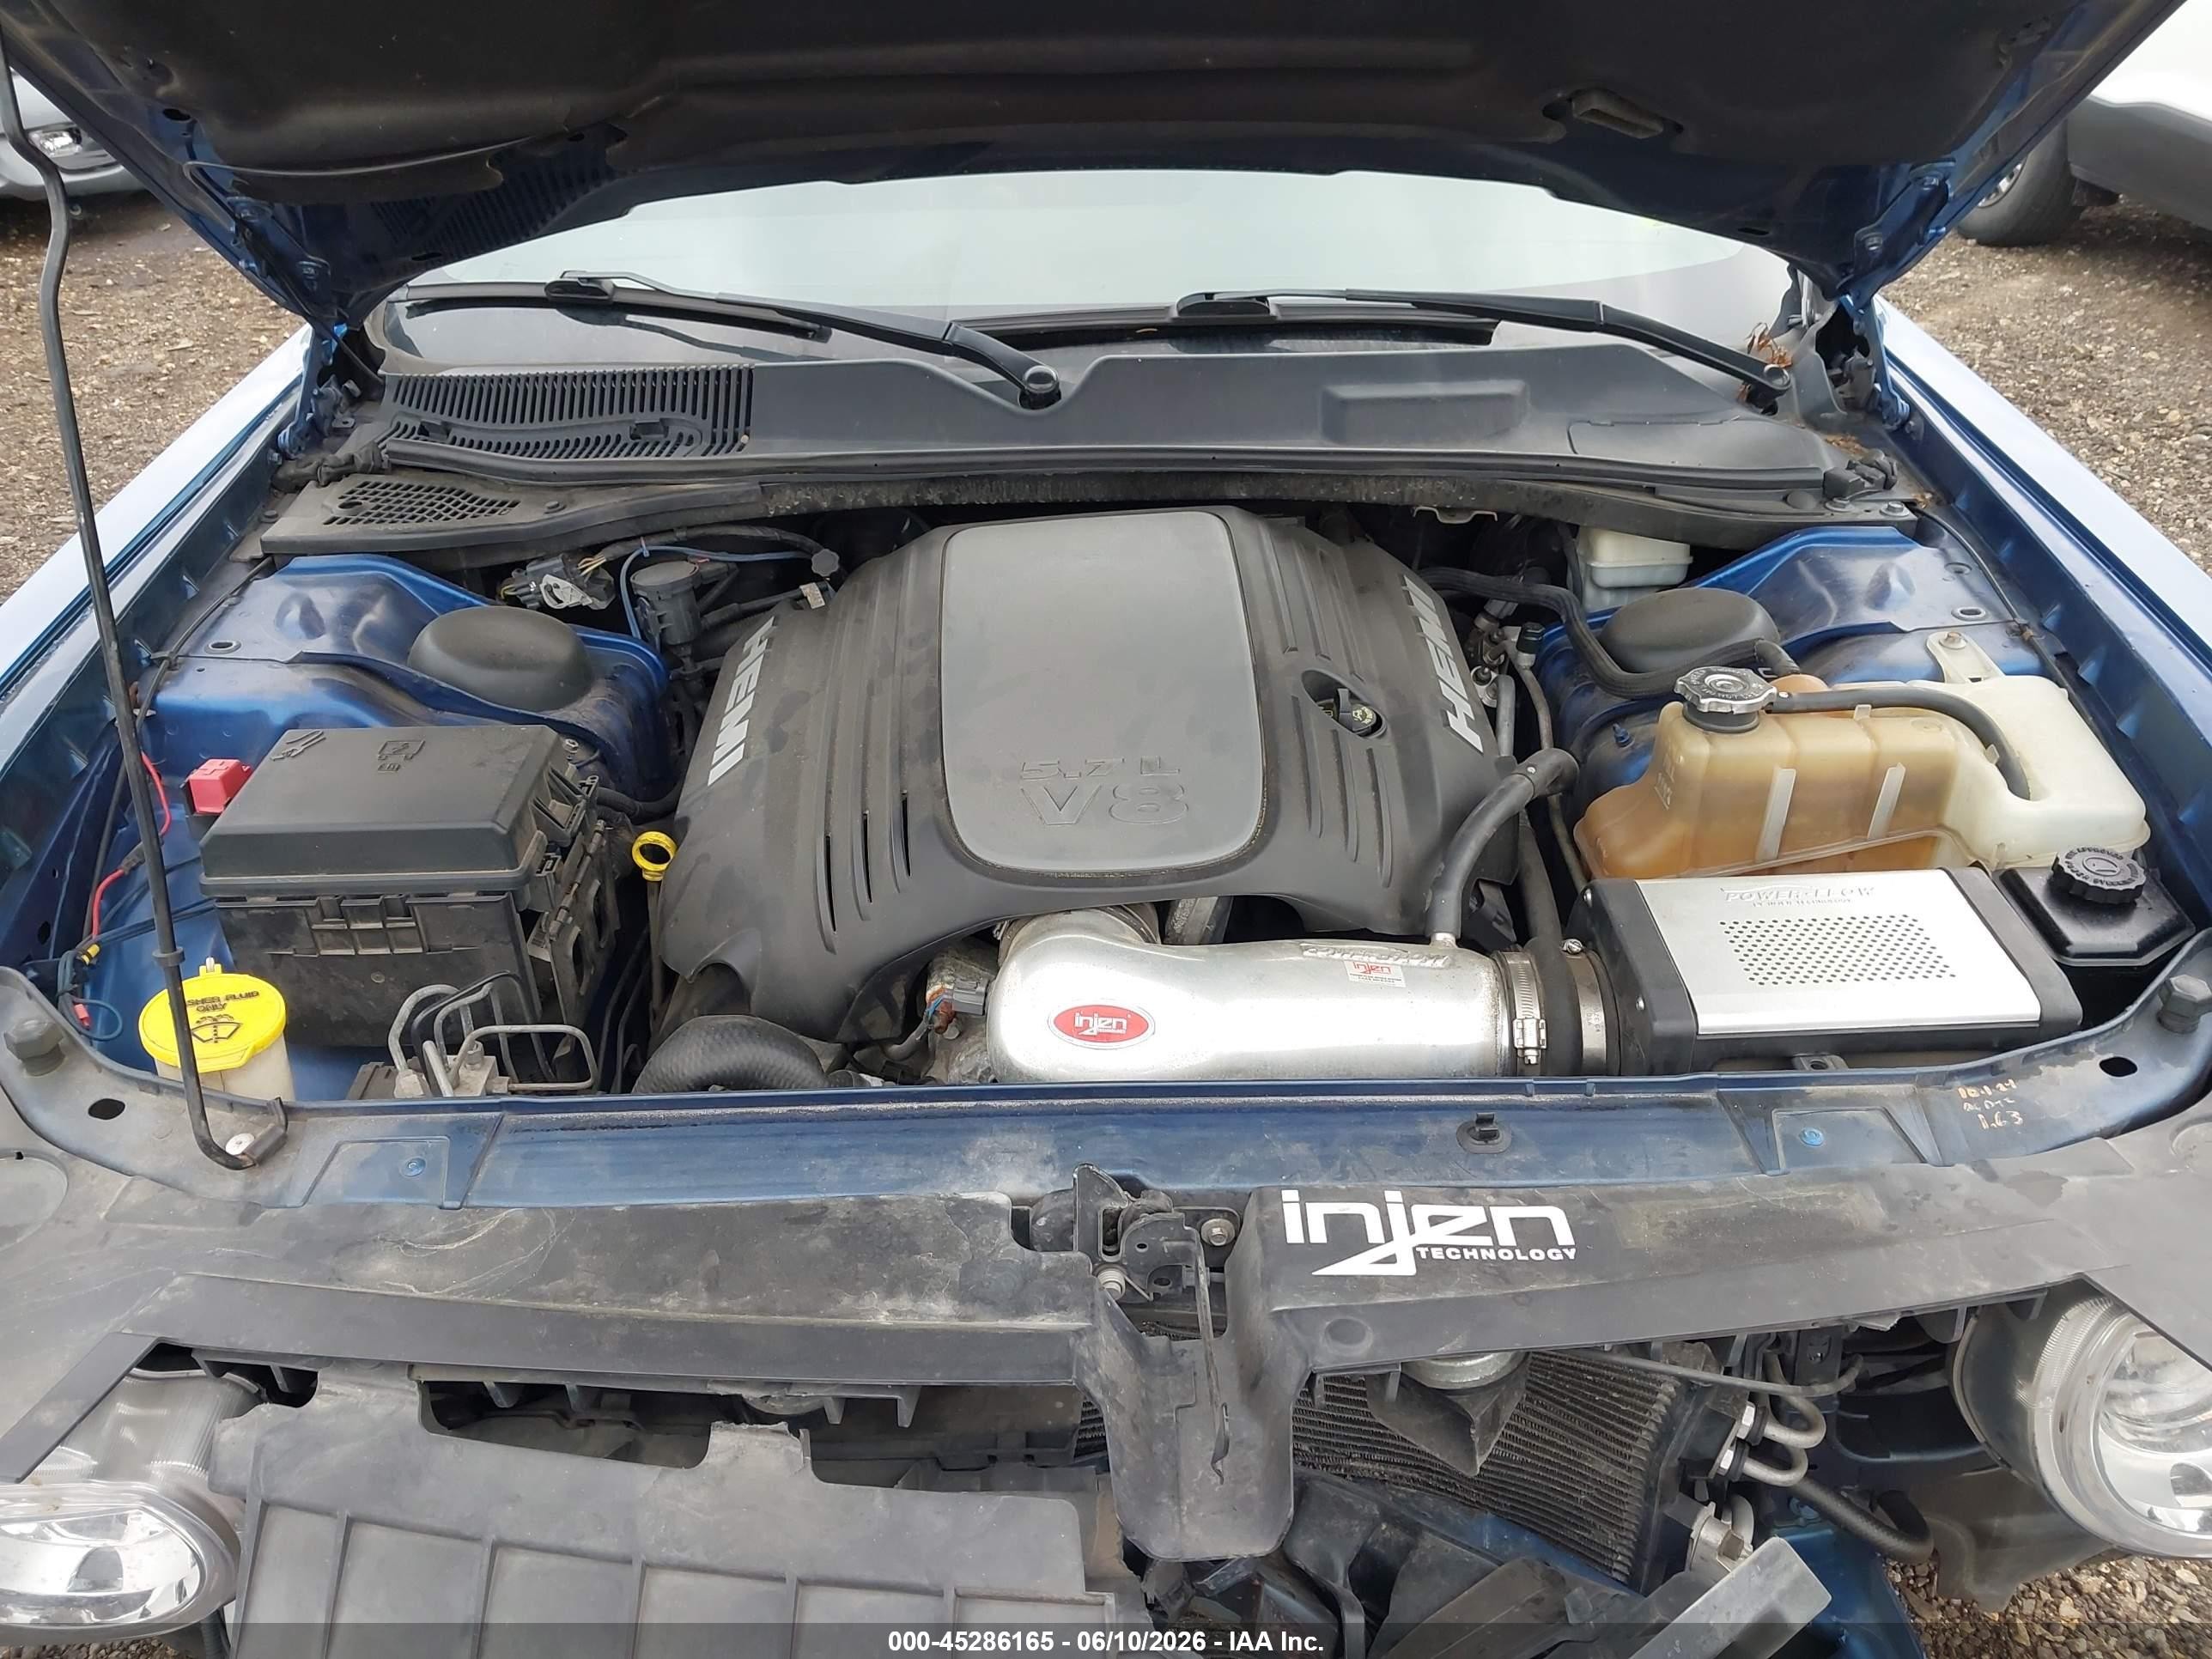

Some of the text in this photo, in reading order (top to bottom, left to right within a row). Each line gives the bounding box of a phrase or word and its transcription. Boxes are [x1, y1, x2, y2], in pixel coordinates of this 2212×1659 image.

[1403, 574, 1484, 753] HEMI
[708, 616, 775, 787] HEMI
[1019, 783, 1189, 825] V8
[186, 990, 260, 1007] SHER FLUID
[196, 1002, 228, 1013] ONLY
[1415, 1246, 1577, 1261] TECHNOLOGY
